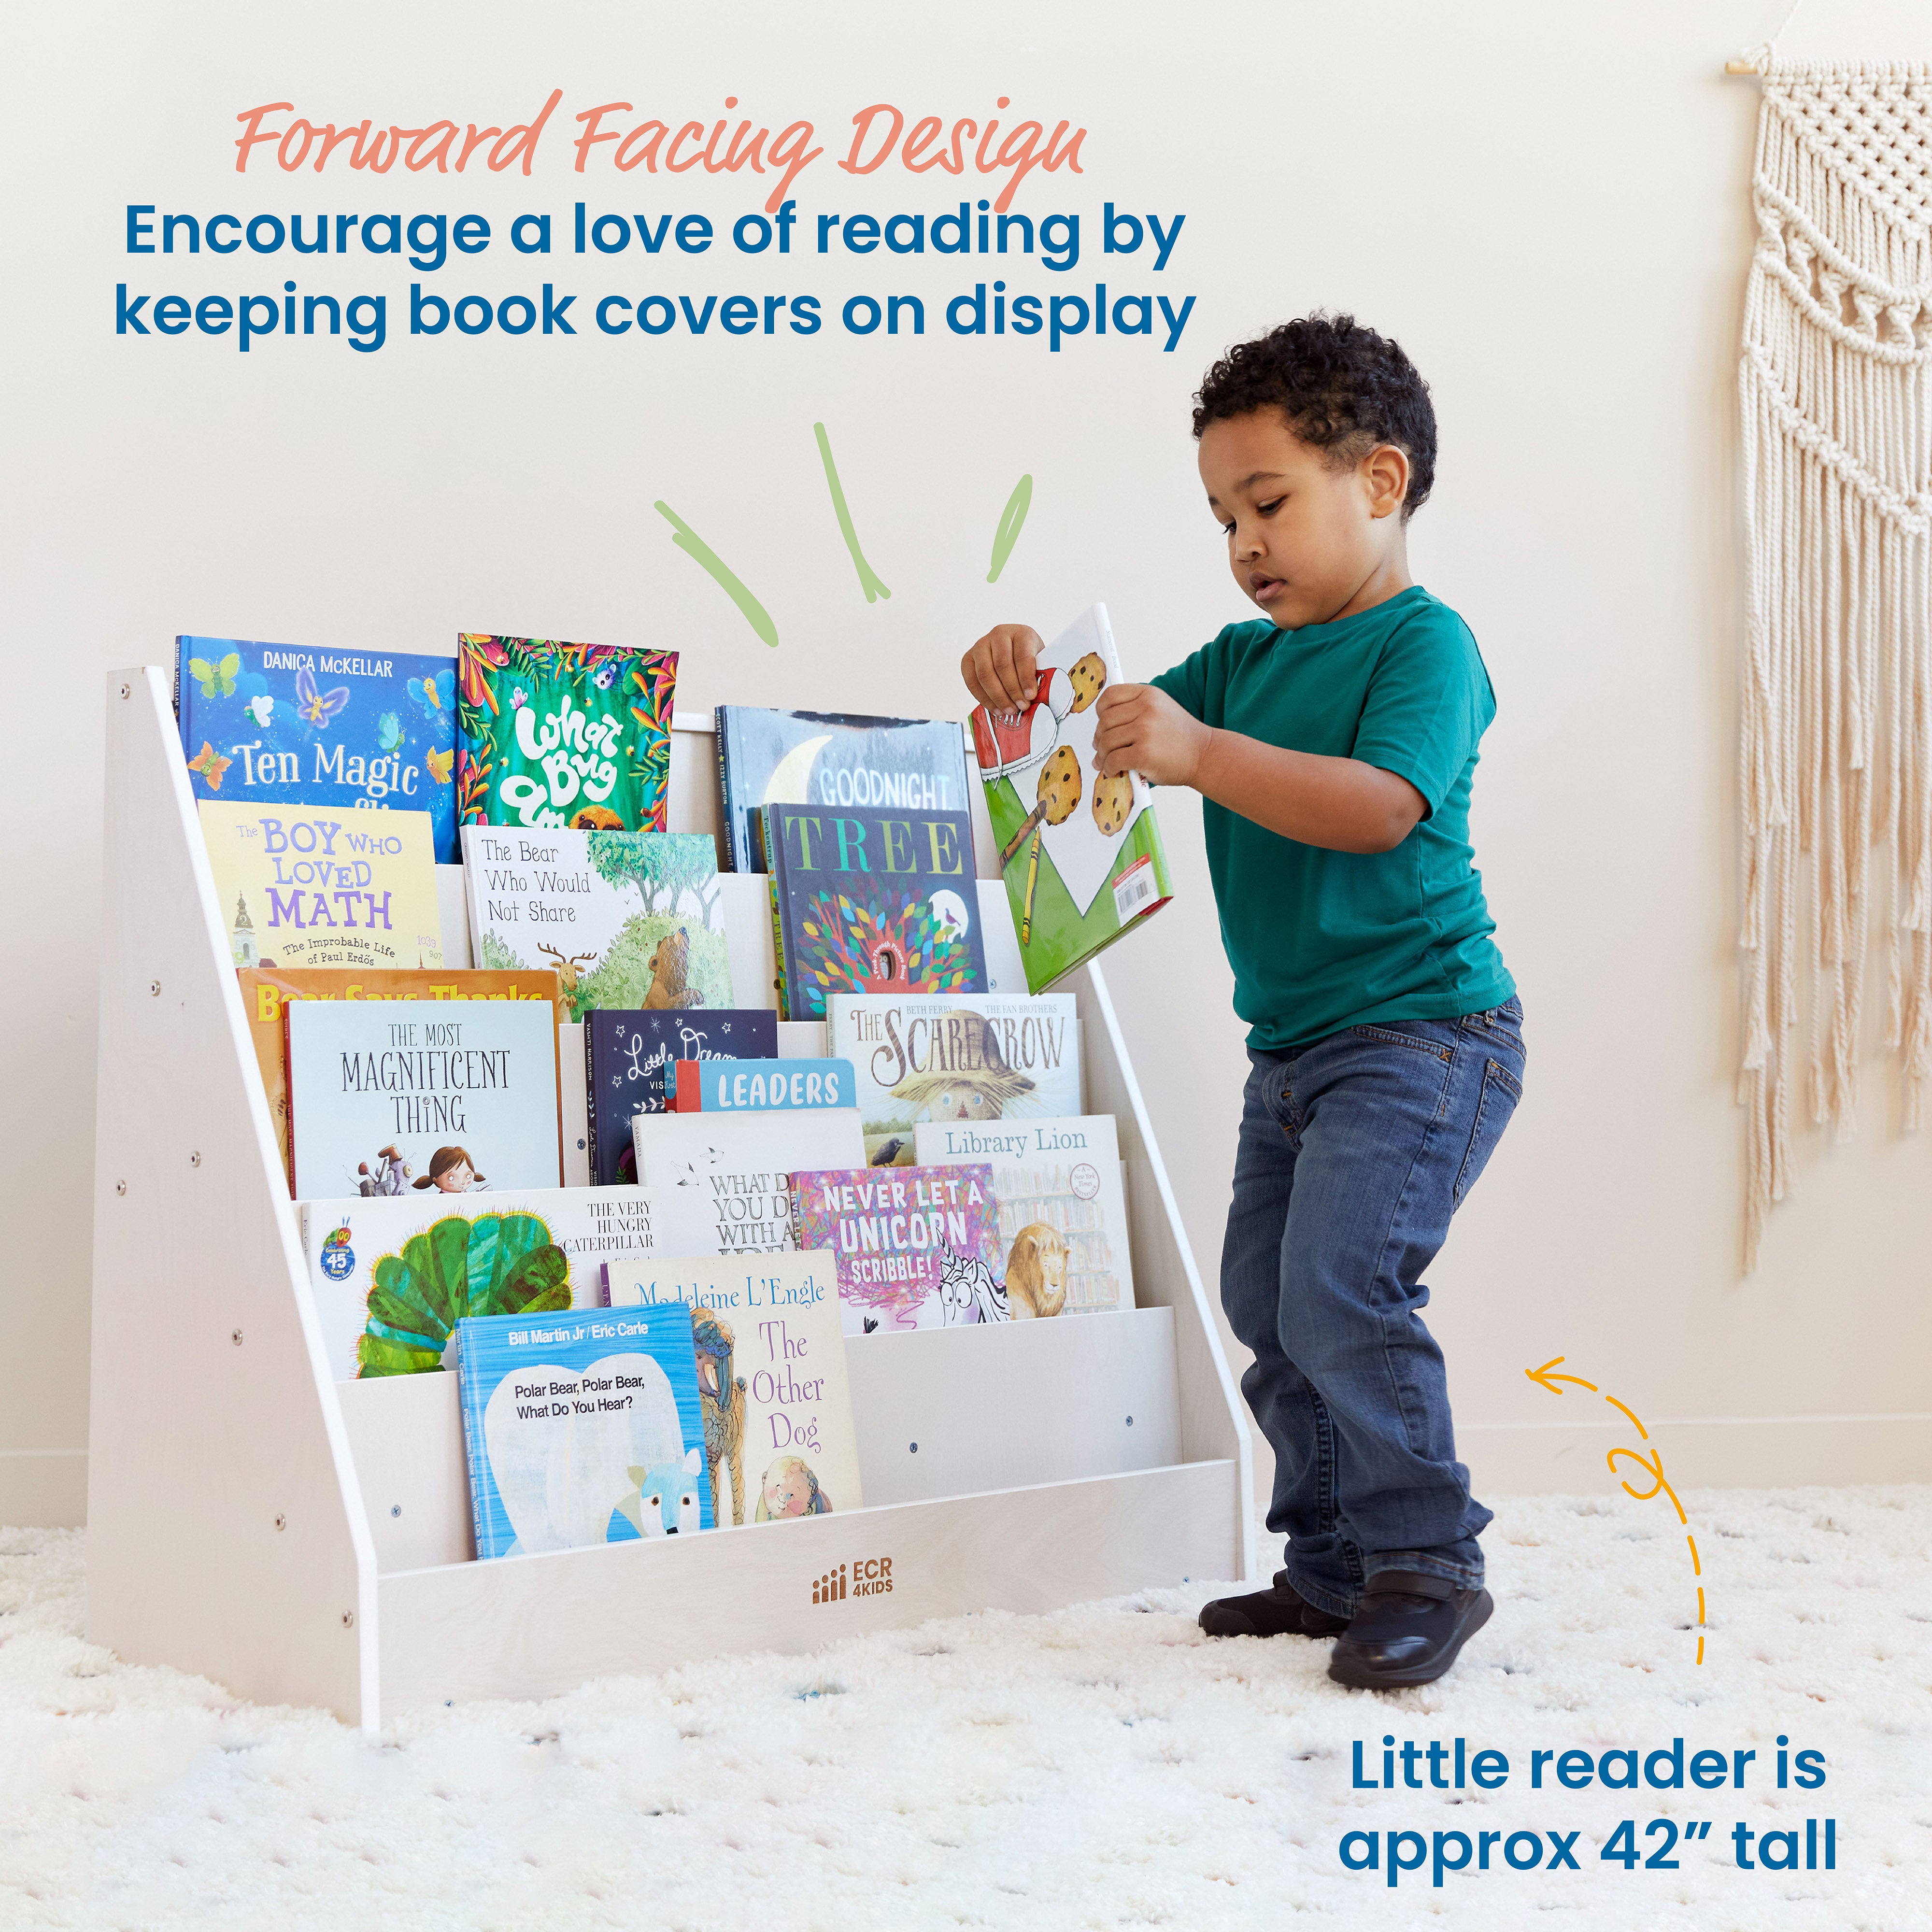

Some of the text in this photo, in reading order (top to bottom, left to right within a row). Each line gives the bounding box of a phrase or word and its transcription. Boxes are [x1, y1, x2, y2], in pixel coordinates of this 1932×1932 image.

[264, 651, 393, 677] DANICA McKELLAR
[515, 694, 624, 760] What
[232, 740, 419, 798] Ten Magic
[541, 750, 617, 807] Bug
[236, 819, 403, 855] The BOY WHO
[724, 822, 733, 866] GOODNIGHT
[785, 816, 963, 875] TREE
[482, 839, 559, 862] The Bear
[271, 857, 372, 889] LOVED
[484, 869, 591, 893] Who Would
[240, 915, 248, 925] 2
[265, 887, 393, 930] MATH
[488, 900, 576, 922] Not Share
[283, 937, 396, 958] The Improbable Life
[417, 935, 436, 948] 1039
[774, 921, 783, 960] TREE
[891, 943, 904, 963] Picture
[308, 955, 317, 965] of
[321, 952, 344, 962] Paul
[429, 950, 442, 960] 907
[907, 1005, 953, 1015] BETH FERRY
[985, 1005, 1057, 1013] THE FAN BROTHERS
[388, 1023, 462, 1047] THE MOST
[850, 1007, 1065, 1087] THE SCARECROW
[340, 1050, 511, 1092] MAGNIFICENT
[718, 1073, 839, 1108] LEADERS
[945, 1127, 1088, 1159] Library Lion
[709, 1173, 770, 1196] WHAT
[823, 1179, 984, 1212] NEVER LET A
[587, 1200, 652, 1217] THE VERY
[712, 1196, 763, 1222] YOU
[790, 1191, 799, 1223] NEVER
[597, 1218, 652, 1234] HUNGRY
[715, 1222, 776, 1246] WITH
[839, 1211, 967, 1253] UNICORN
[563, 1234, 654, 1252] CATERPILLAR
[327, 1253, 346, 1268] 45
[851, 1256, 933, 1284] SCRIBBLE!
[508, 1331, 529, 1346] Bill
[531, 1328, 570, 1345] Martin
[572, 1326, 584, 1341] Jr
[592, 1323, 616, 1338] Eric
[617, 1321, 649, 1337] Carle
[758, 1321, 809, 1362] The
[514, 1375, 645, 1399] Polar Bear, Polar Bear,
[752, 1364, 824, 1405] Other
[516, 1396, 633, 1420] What Do You Hear?
[767, 1412, 822, 1454] Dog
[476, 1524, 482, 1536] Do
[853, 1557, 893, 1582] ECR
[853, 1579, 894, 1597] 4KIDS
